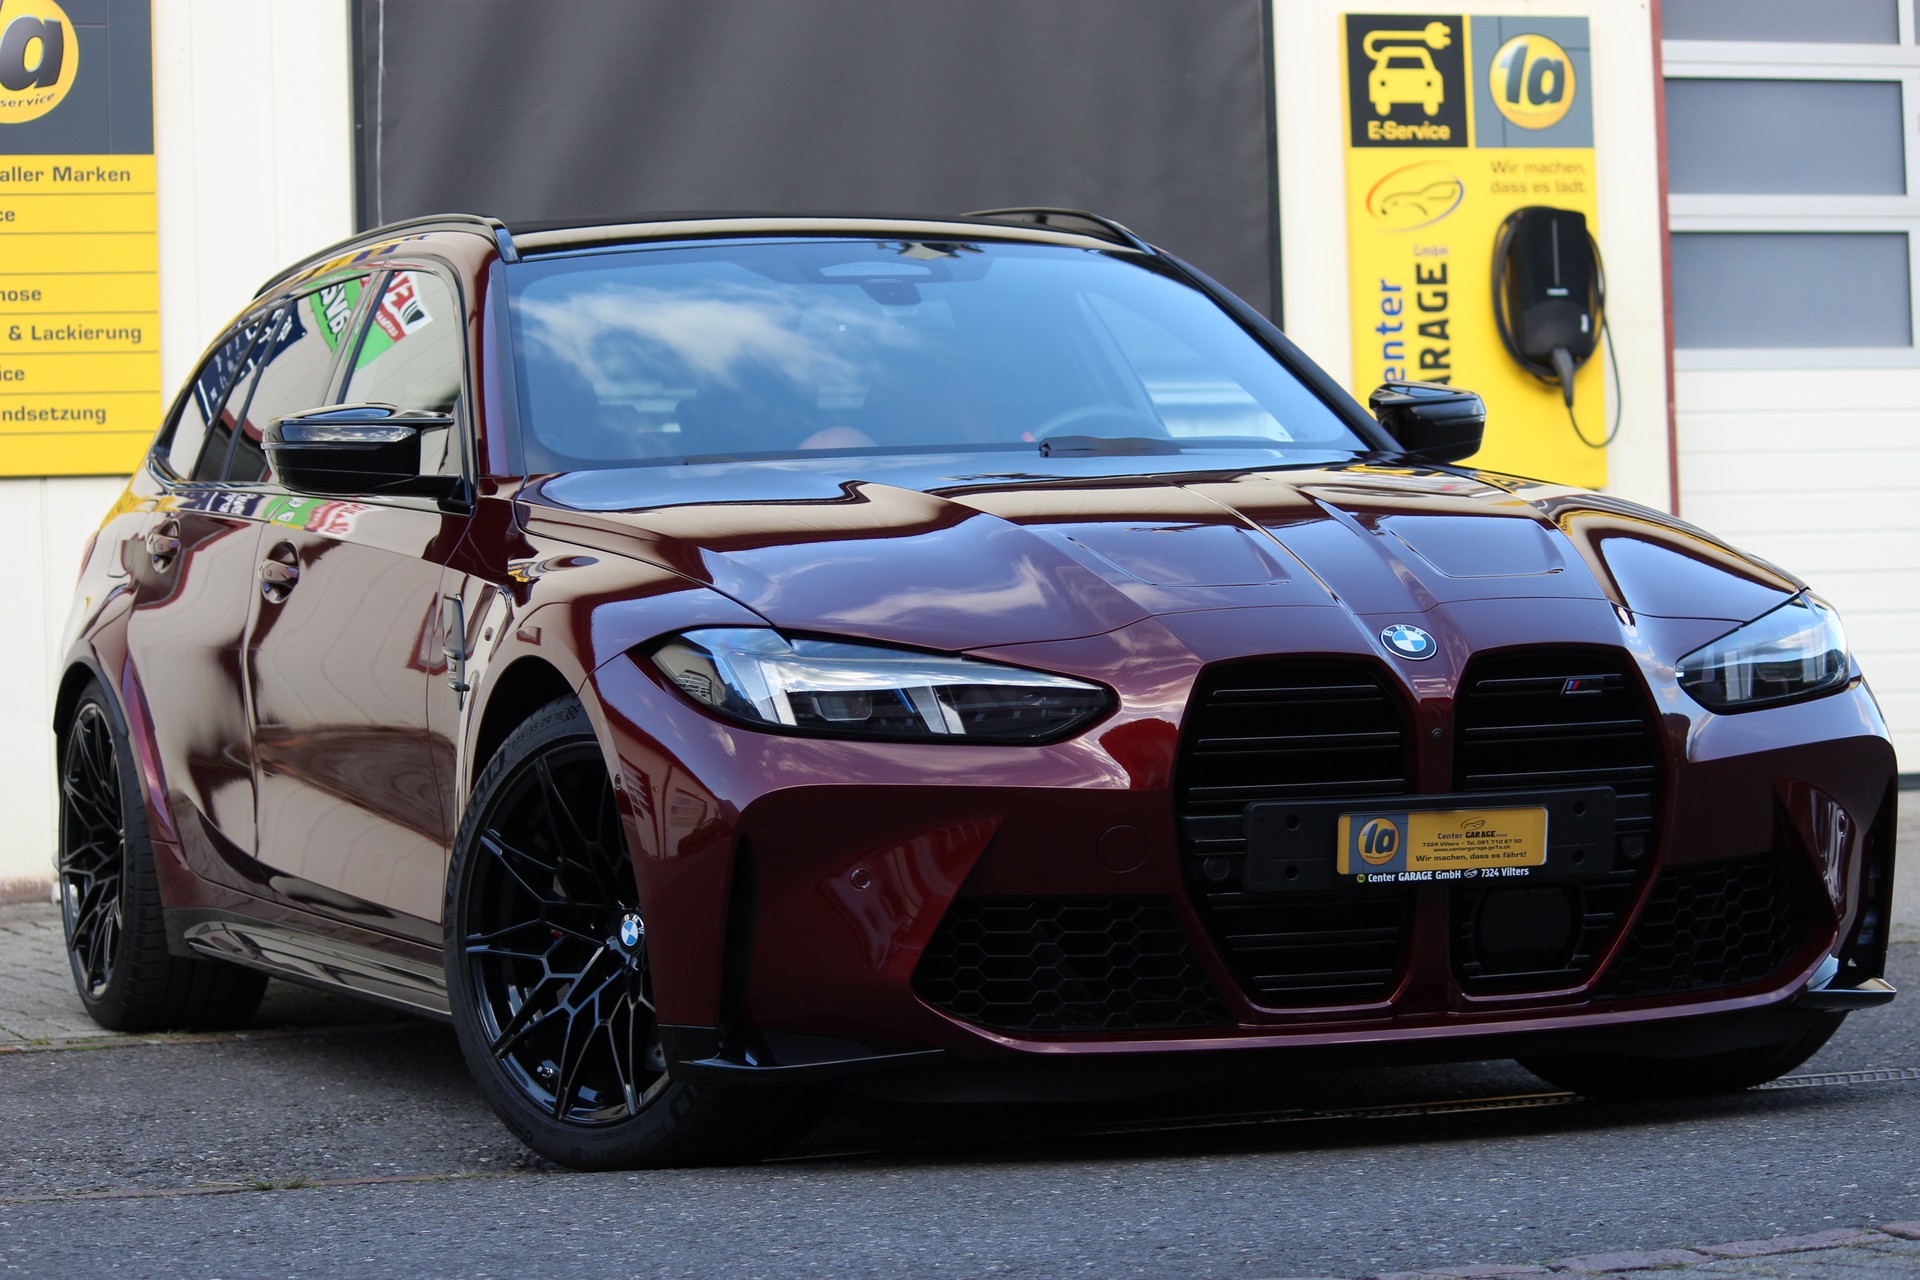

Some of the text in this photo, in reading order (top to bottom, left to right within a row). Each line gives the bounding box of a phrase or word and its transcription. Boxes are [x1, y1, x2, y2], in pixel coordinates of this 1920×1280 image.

[1500, 44, 1565, 106] 1a
[1367, 120, 1451, 141] E-Service
[0, 166, 131, 182] aller Marken
[1489, 160, 1519, 173] Wir
[1533, 183, 1551, 193] es
[8, 323, 142, 344] & Lackierung
[1, 405, 106, 425] ndsetzung
[1362, 822, 1395, 854] 1a
[1437, 832, 1463, 840] Center
[1465, 830, 1496, 839] GARAGE
[1415, 854, 1432, 862] Wir
[1367, 872, 1396, 883] Center
[1398, 870, 1433, 882] GARAGE
[1435, 869, 1461, 880] GmbH
[1481, 867, 1500, 878] 7324
[1501, 866, 1530, 877] Vilters
